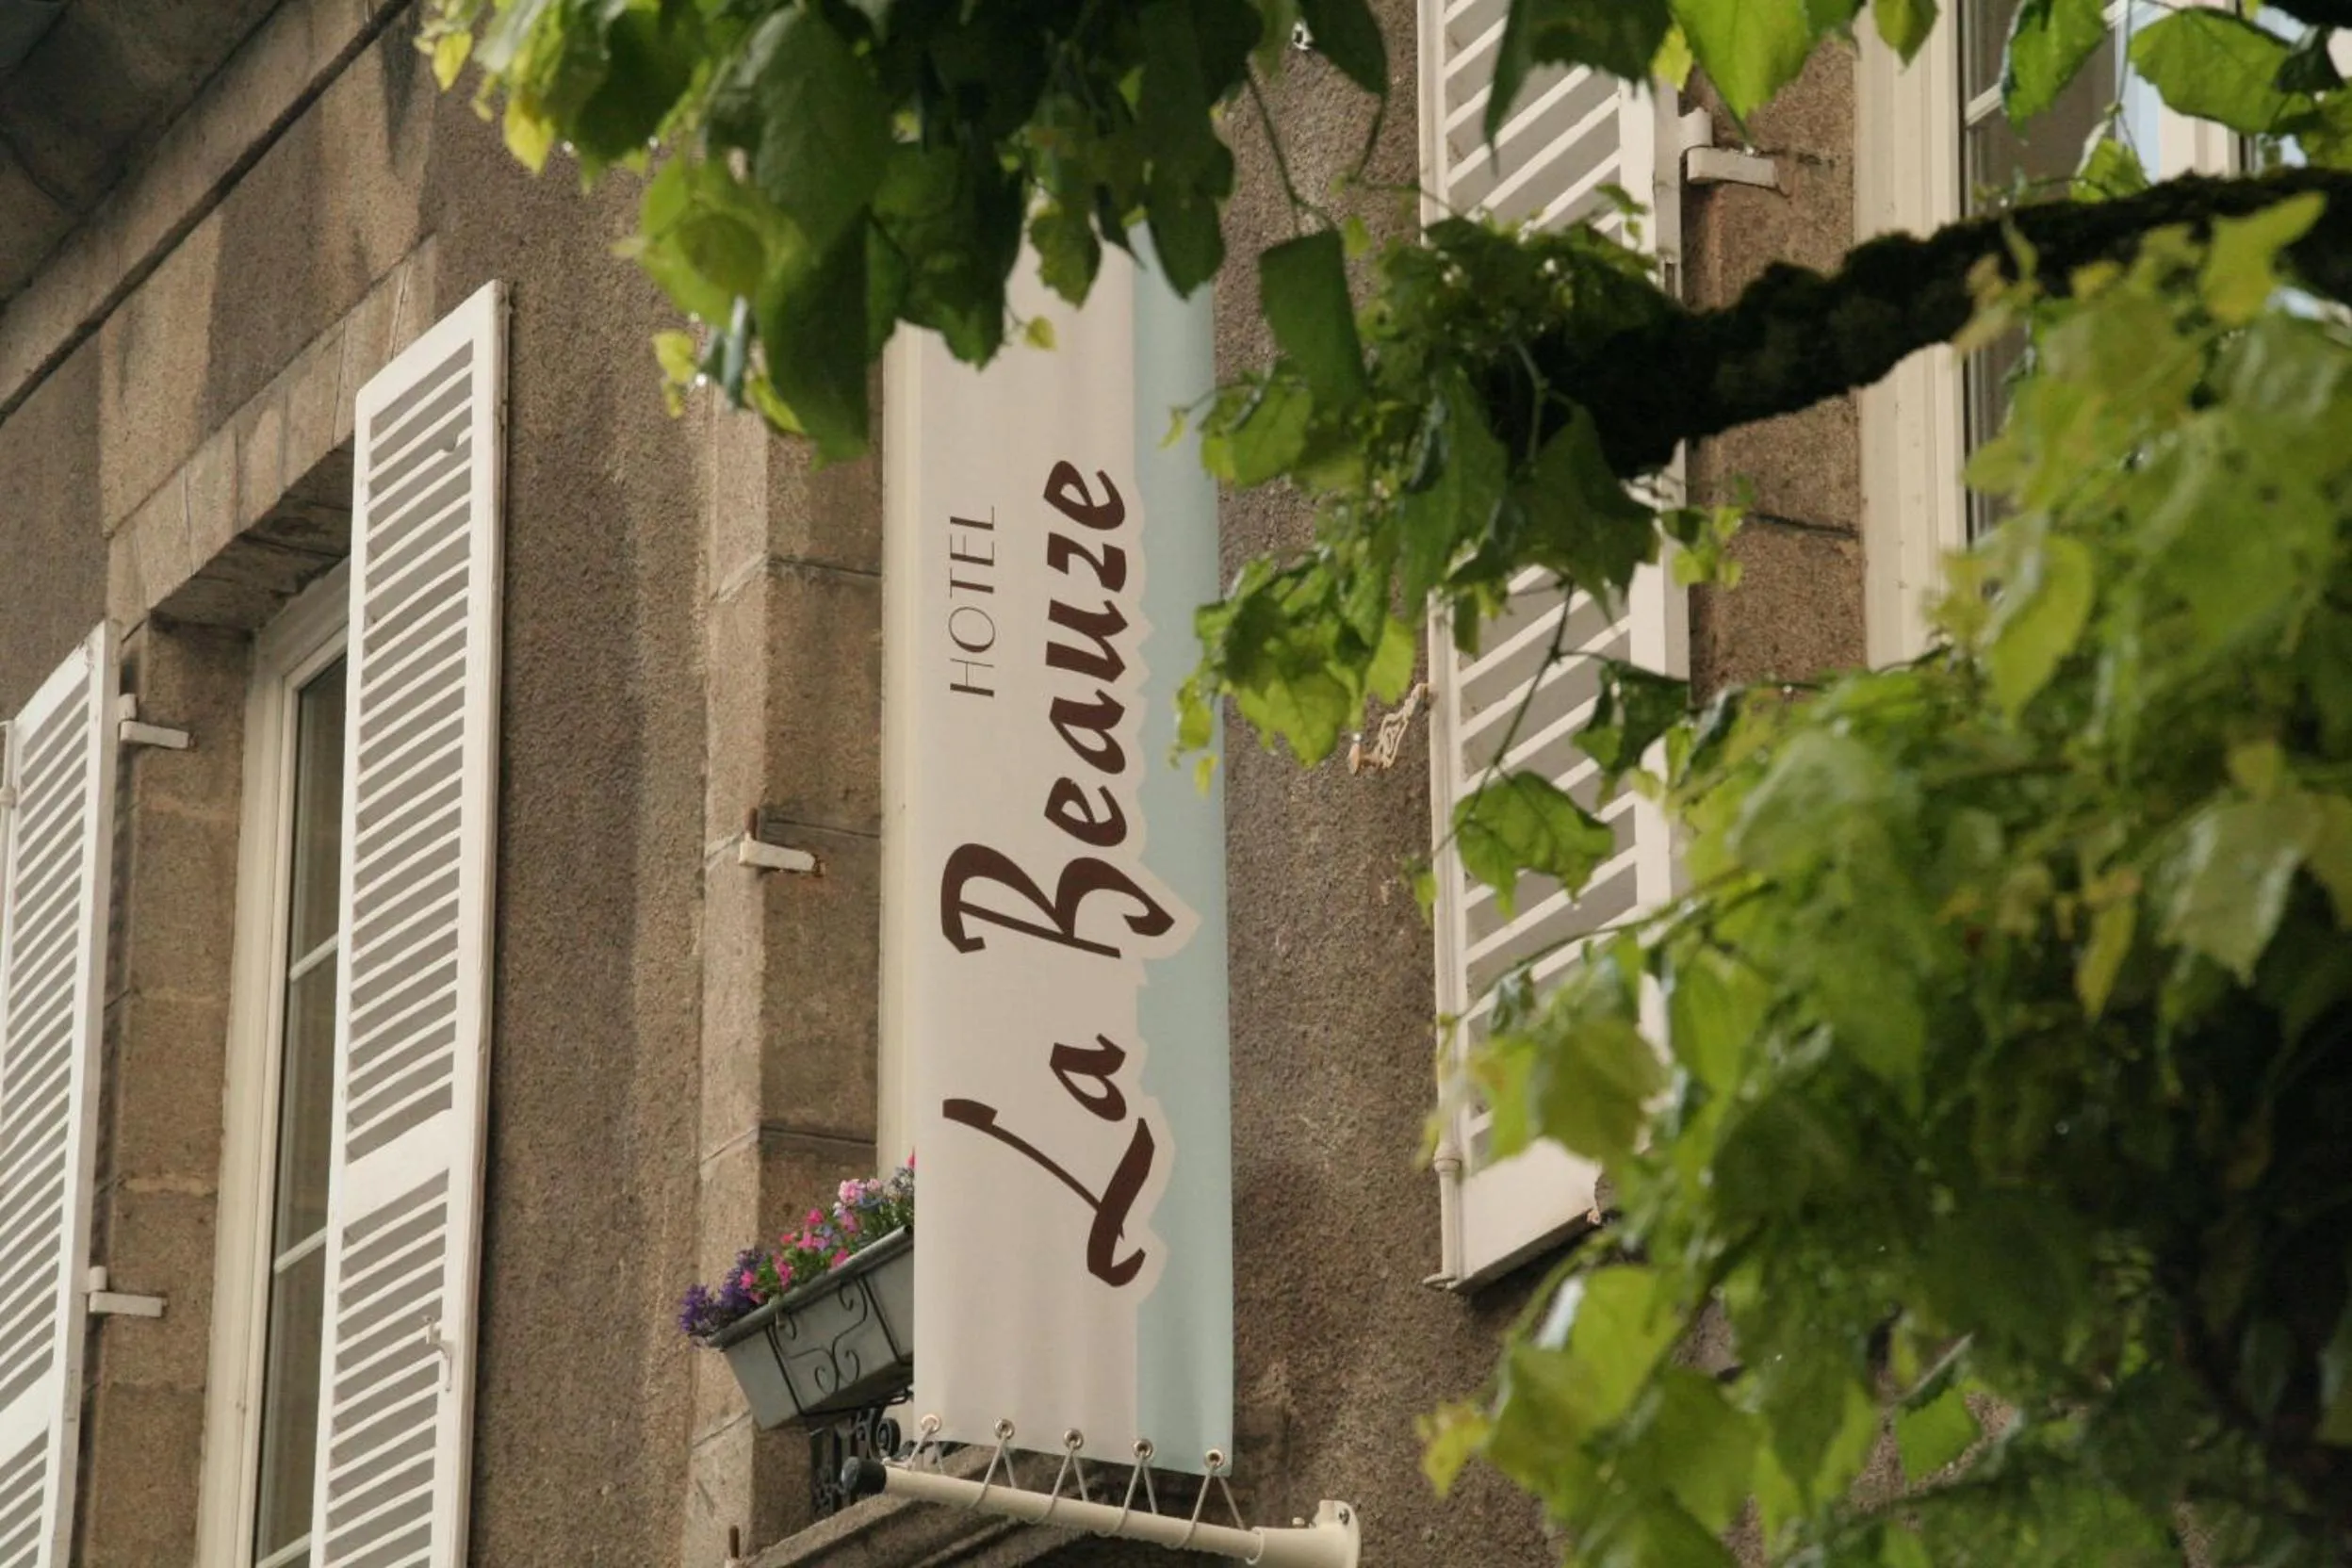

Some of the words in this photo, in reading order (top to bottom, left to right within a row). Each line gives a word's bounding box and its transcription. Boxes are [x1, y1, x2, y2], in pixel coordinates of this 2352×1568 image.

[941, 461, 1174, 959] Beauze
[948, 506, 996, 697] HOTEL
[943, 1034, 1154, 1288] La
